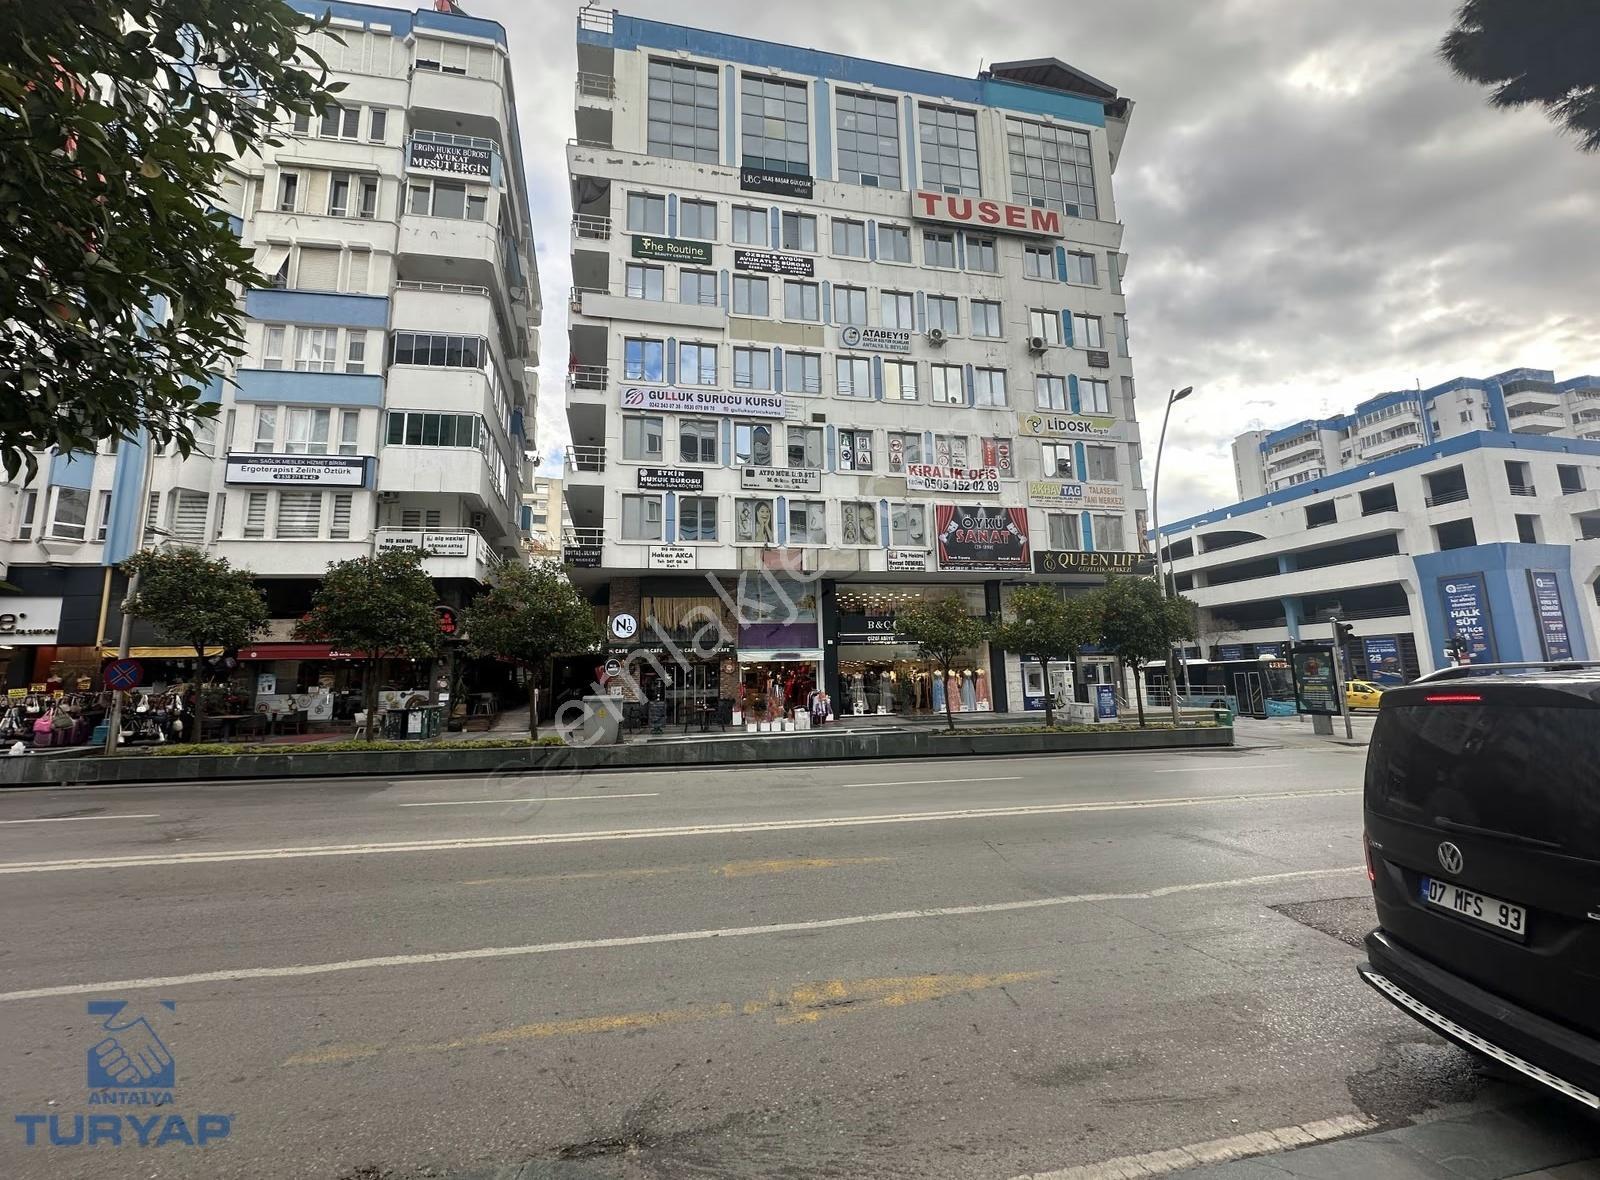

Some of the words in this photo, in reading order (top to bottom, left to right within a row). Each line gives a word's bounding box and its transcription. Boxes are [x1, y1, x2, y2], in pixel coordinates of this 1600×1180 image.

[413, 143, 436, 152] ERGİN
[436, 146, 462, 156] HUKUK
[462, 149, 490, 159] BÜROSU
[434, 154, 469, 164] AVUKAT
[412, 157, 451, 169] MESUT
[454, 162, 489, 174] ERGİN
[743, 174, 760, 184] UBG
[918, 192, 1060, 234] TUSEM
[642, 238, 664, 252] The
[666, 243, 704, 256] Routine
[739, 256, 780, 265] AVUKATLIK
[862, 330, 910, 340] ATABEY19
[745, 396, 782, 408] KURSU
[1047, 417, 1092, 433] LİDOSK
[241, 465, 294, 473] Ergoterapist
[952, 480, 970, 491] 152
[987, 481, 999, 492] 89
[1062, 486, 1080, 496] TAG
[962, 514, 1004, 530] ÖYKÜ
[955, 528, 1010, 544] SANAT
[1058, 552, 1109, 569] QUEEN
[1450, 609, 1480, 618] HALK
[1456, 617, 1478, 626] SÜT
[1429, 882, 1446, 903] 07
[1454, 888, 1484, 917] MFS
[1498, 904, 1522, 931] 93
